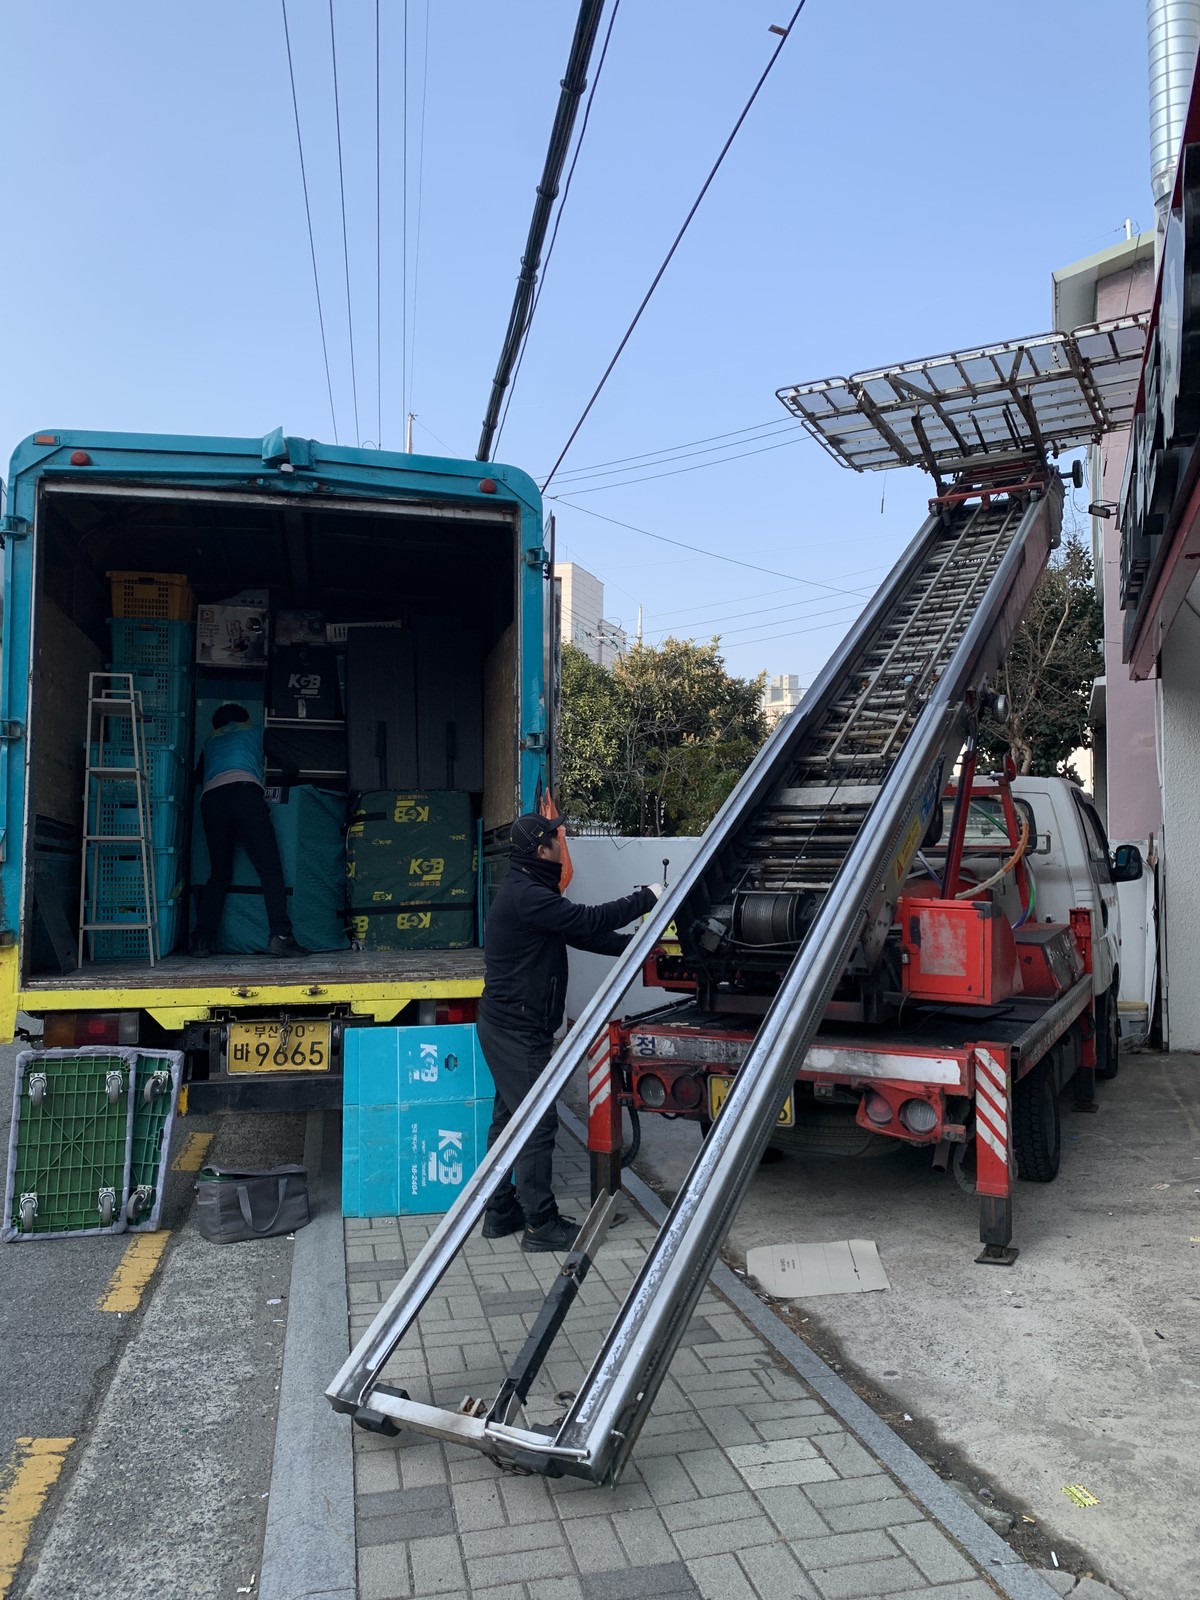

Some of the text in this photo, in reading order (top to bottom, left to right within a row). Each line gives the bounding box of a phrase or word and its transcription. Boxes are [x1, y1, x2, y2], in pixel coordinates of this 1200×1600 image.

[288, 673, 321, 688] KGB
[394, 806, 429, 822] KGB
[409, 858, 444, 875] KGB
[372, 893, 392, 901] KGB
[396, 912, 431, 929] KGB
[420, 1043, 438, 1082] KGB
[438, 1129, 462, 1185] KGB
